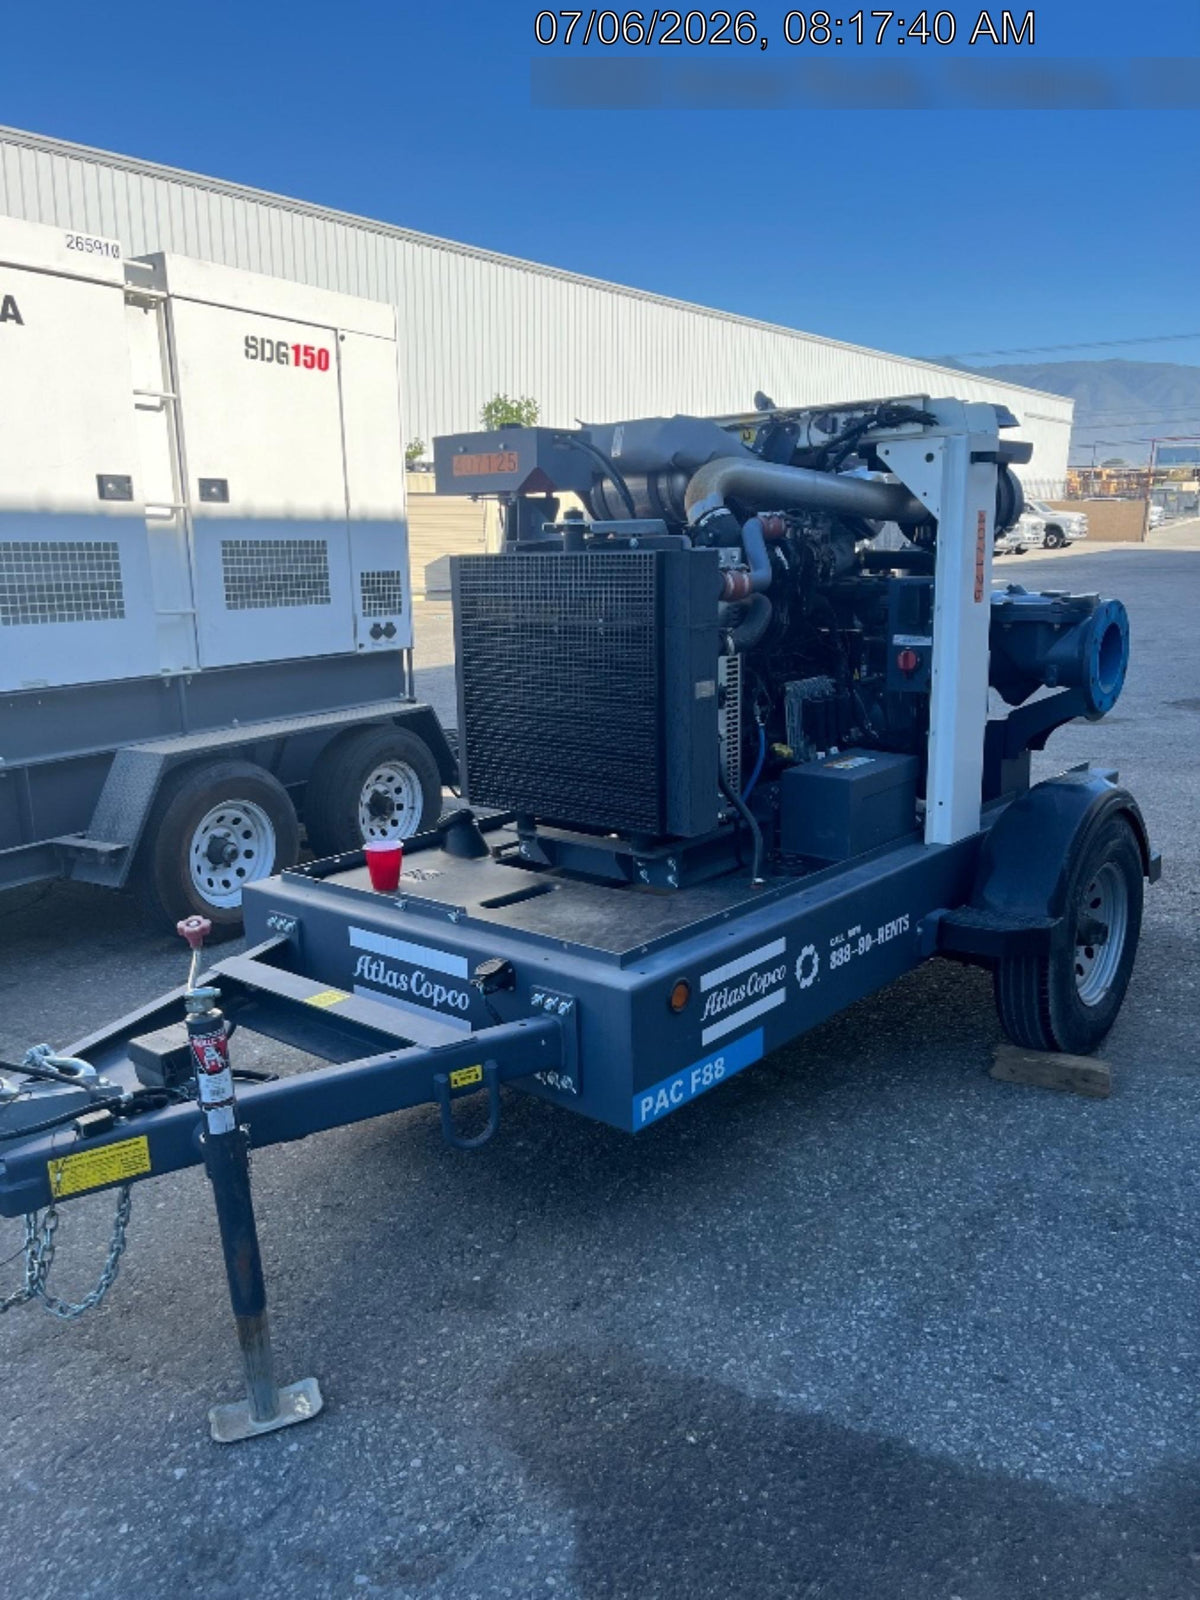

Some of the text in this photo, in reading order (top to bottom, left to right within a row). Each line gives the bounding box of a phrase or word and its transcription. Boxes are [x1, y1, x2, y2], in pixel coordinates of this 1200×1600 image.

[65, 234, 120, 260] 265910
[353, 954, 470, 1010] Atlas Copco
[701, 964, 787, 1021] Atlas Copco
[640, 1056, 726, 1122] PAC F88
